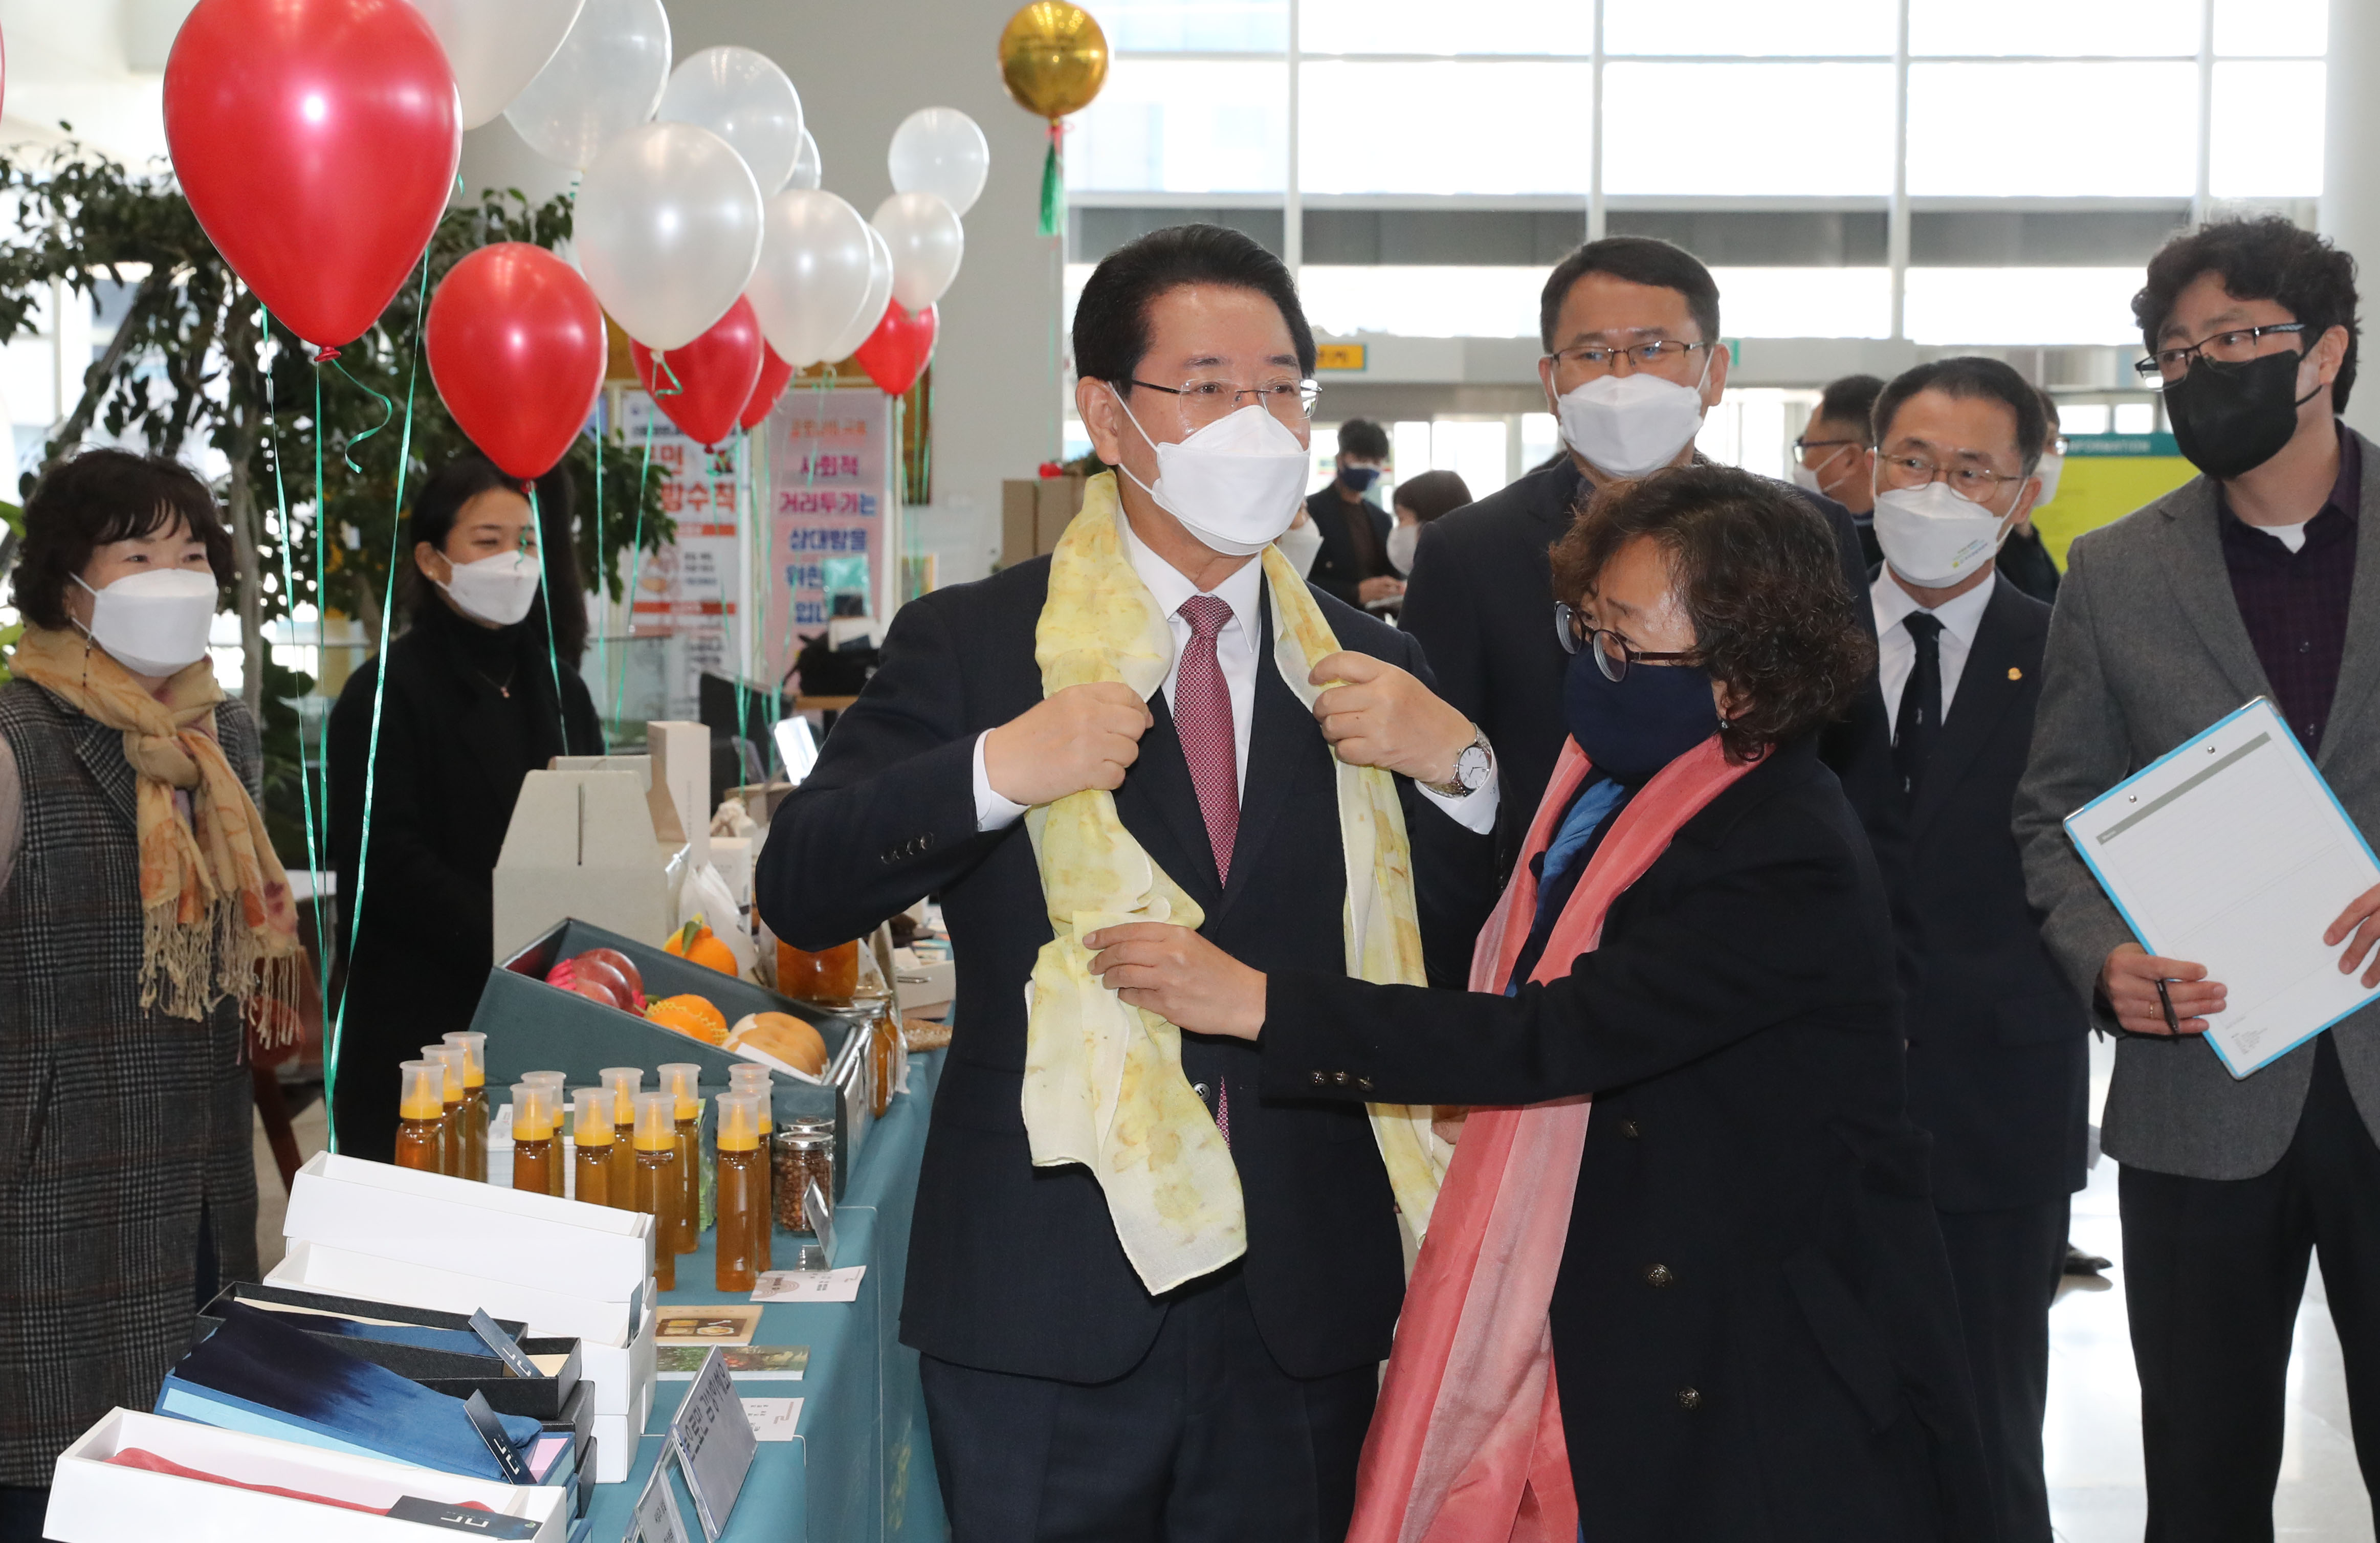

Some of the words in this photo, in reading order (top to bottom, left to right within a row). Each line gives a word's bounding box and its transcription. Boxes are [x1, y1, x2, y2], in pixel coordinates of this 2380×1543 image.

[801, 455, 858, 476] 사회적
[660, 482, 736, 514] 방수칙
[791, 528, 867, 550] 상대방을
